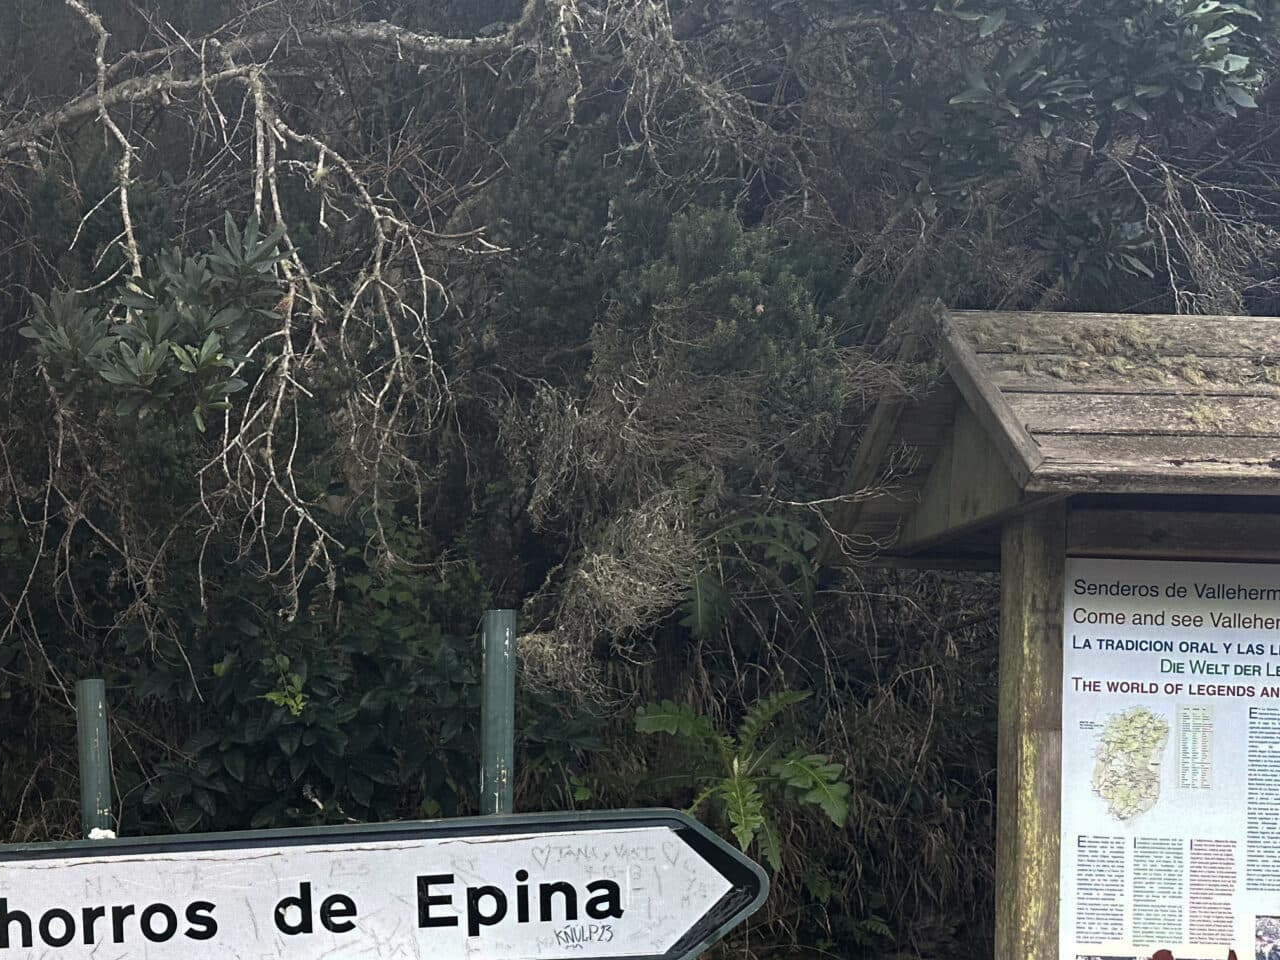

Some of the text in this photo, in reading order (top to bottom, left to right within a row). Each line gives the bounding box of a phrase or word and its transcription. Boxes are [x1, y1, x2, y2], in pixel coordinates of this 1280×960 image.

[1073, 578, 1160, 597] Senderos
[1165, 582, 1188, 598] de
[1073, 607, 1126, 625] Come
[1131, 610, 1165, 626] and
[1170, 614, 1204, 628] see
[1096, 638, 1174, 652] TRADICION
[1178, 641, 1218, 654] ORAL
[1223, 643, 1232, 654] Y
[1237, 643, 1265, 656] LAS
[1234, 664, 1262, 677] DER
[1106, 681, 1159, 694] WORLD
[1163, 683, 1183, 695] OF
[1188, 684, 1256, 697] LEGENDS
[273, 881, 358, 936] de
[416, 869, 625, 938] Epina
